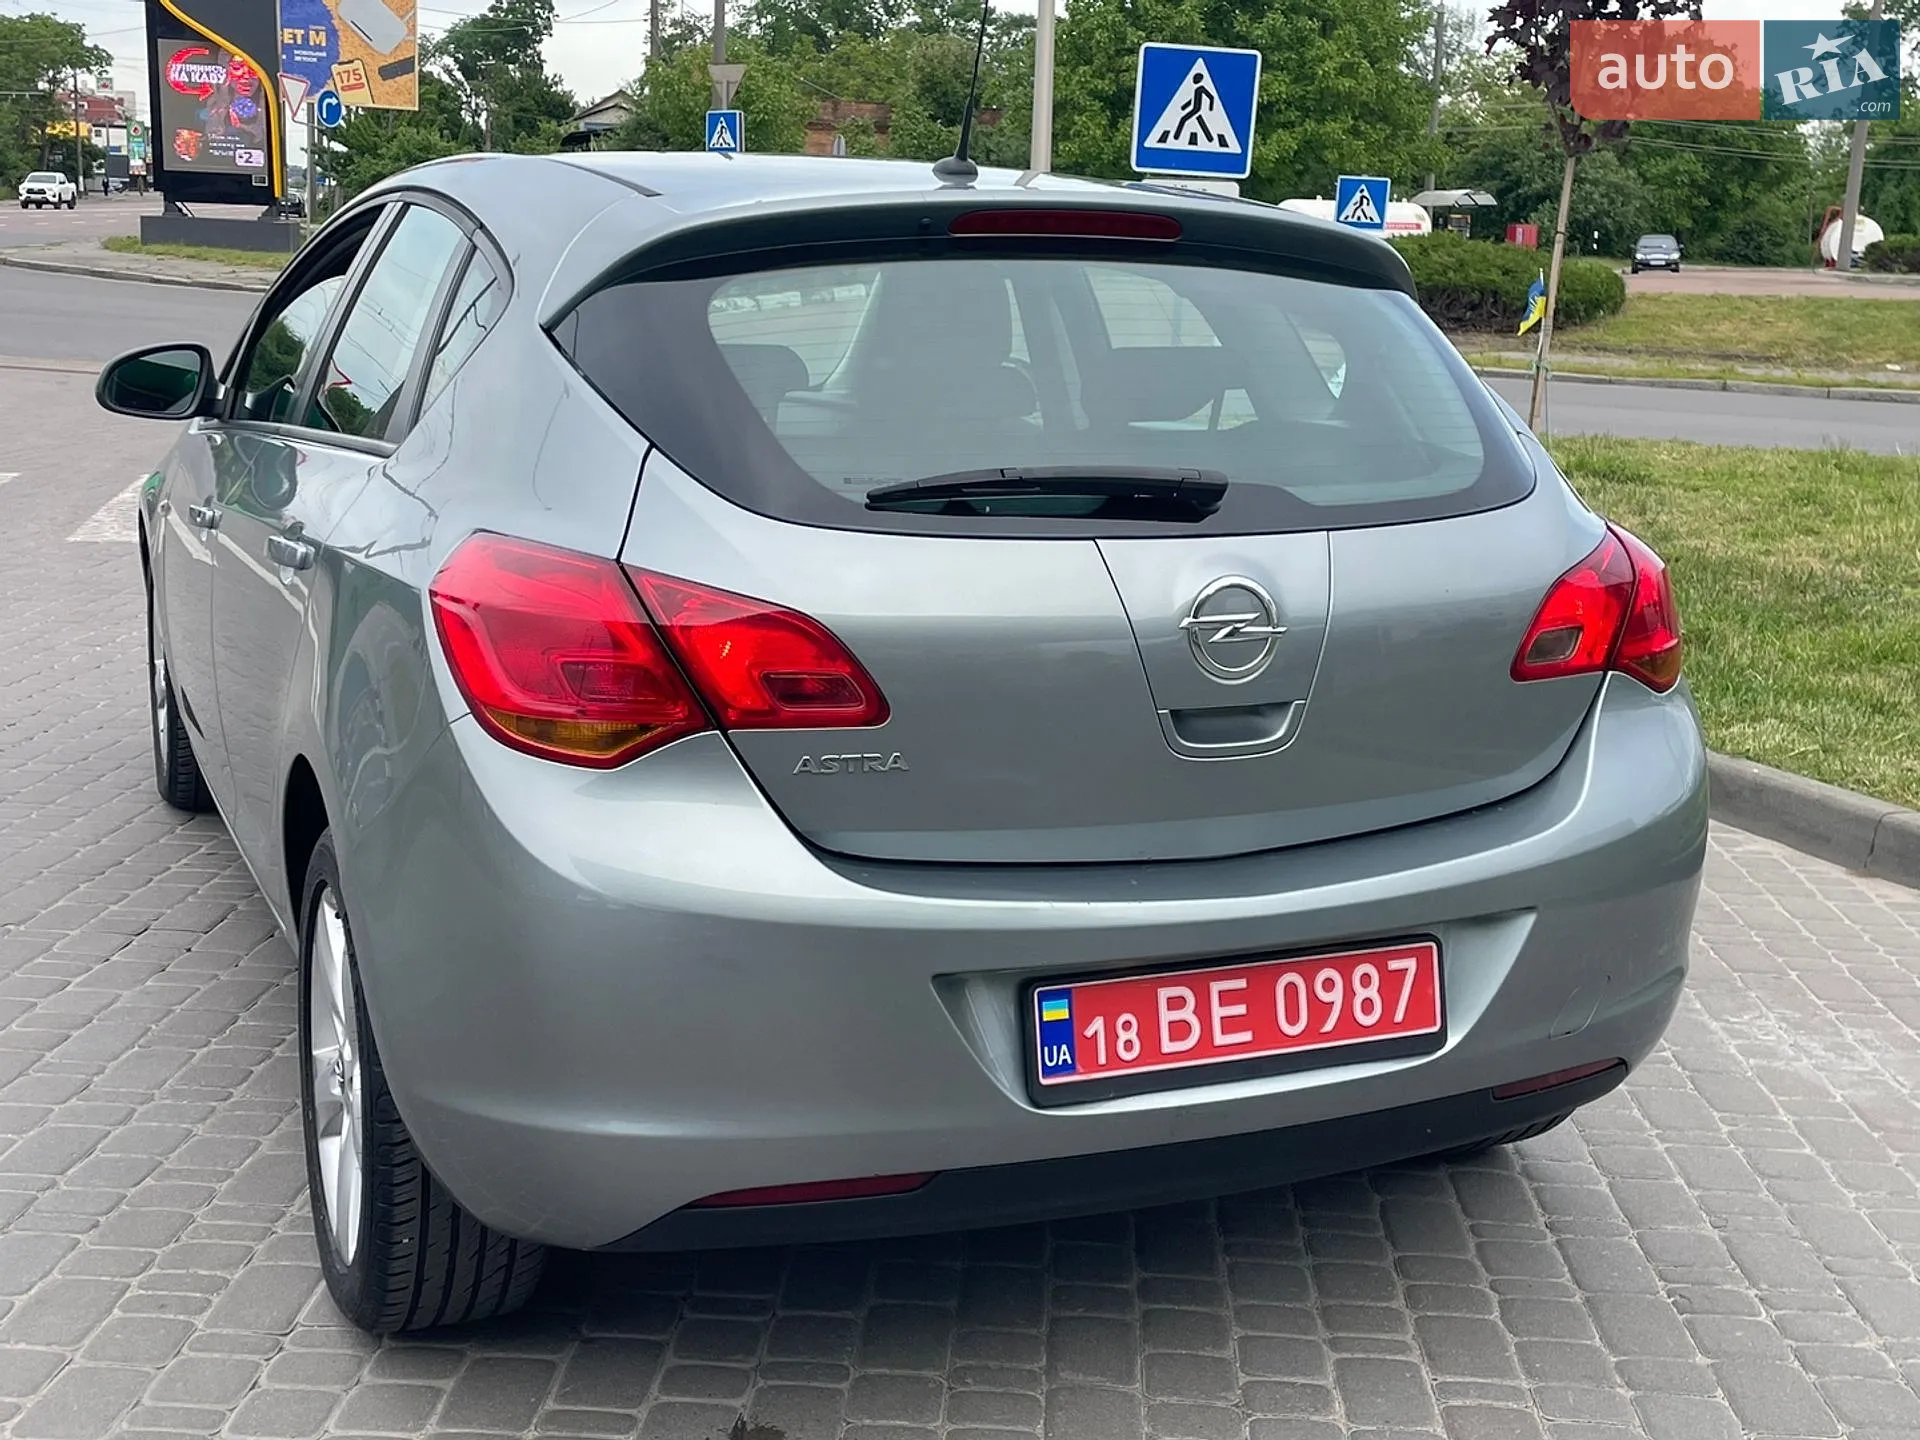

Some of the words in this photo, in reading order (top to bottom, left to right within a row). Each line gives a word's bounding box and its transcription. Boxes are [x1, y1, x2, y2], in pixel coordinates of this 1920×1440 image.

[280, 27, 304, 45] ЕТ
[336, 68, 362, 84] 175
[792, 752, 910, 775] ASTRA
[1083, 1012, 1141, 1065] 18
[1157, 978, 1253, 1054] BE
[1275, 957, 1417, 1037] 0987
[1044, 1044, 1072, 1067] UA
